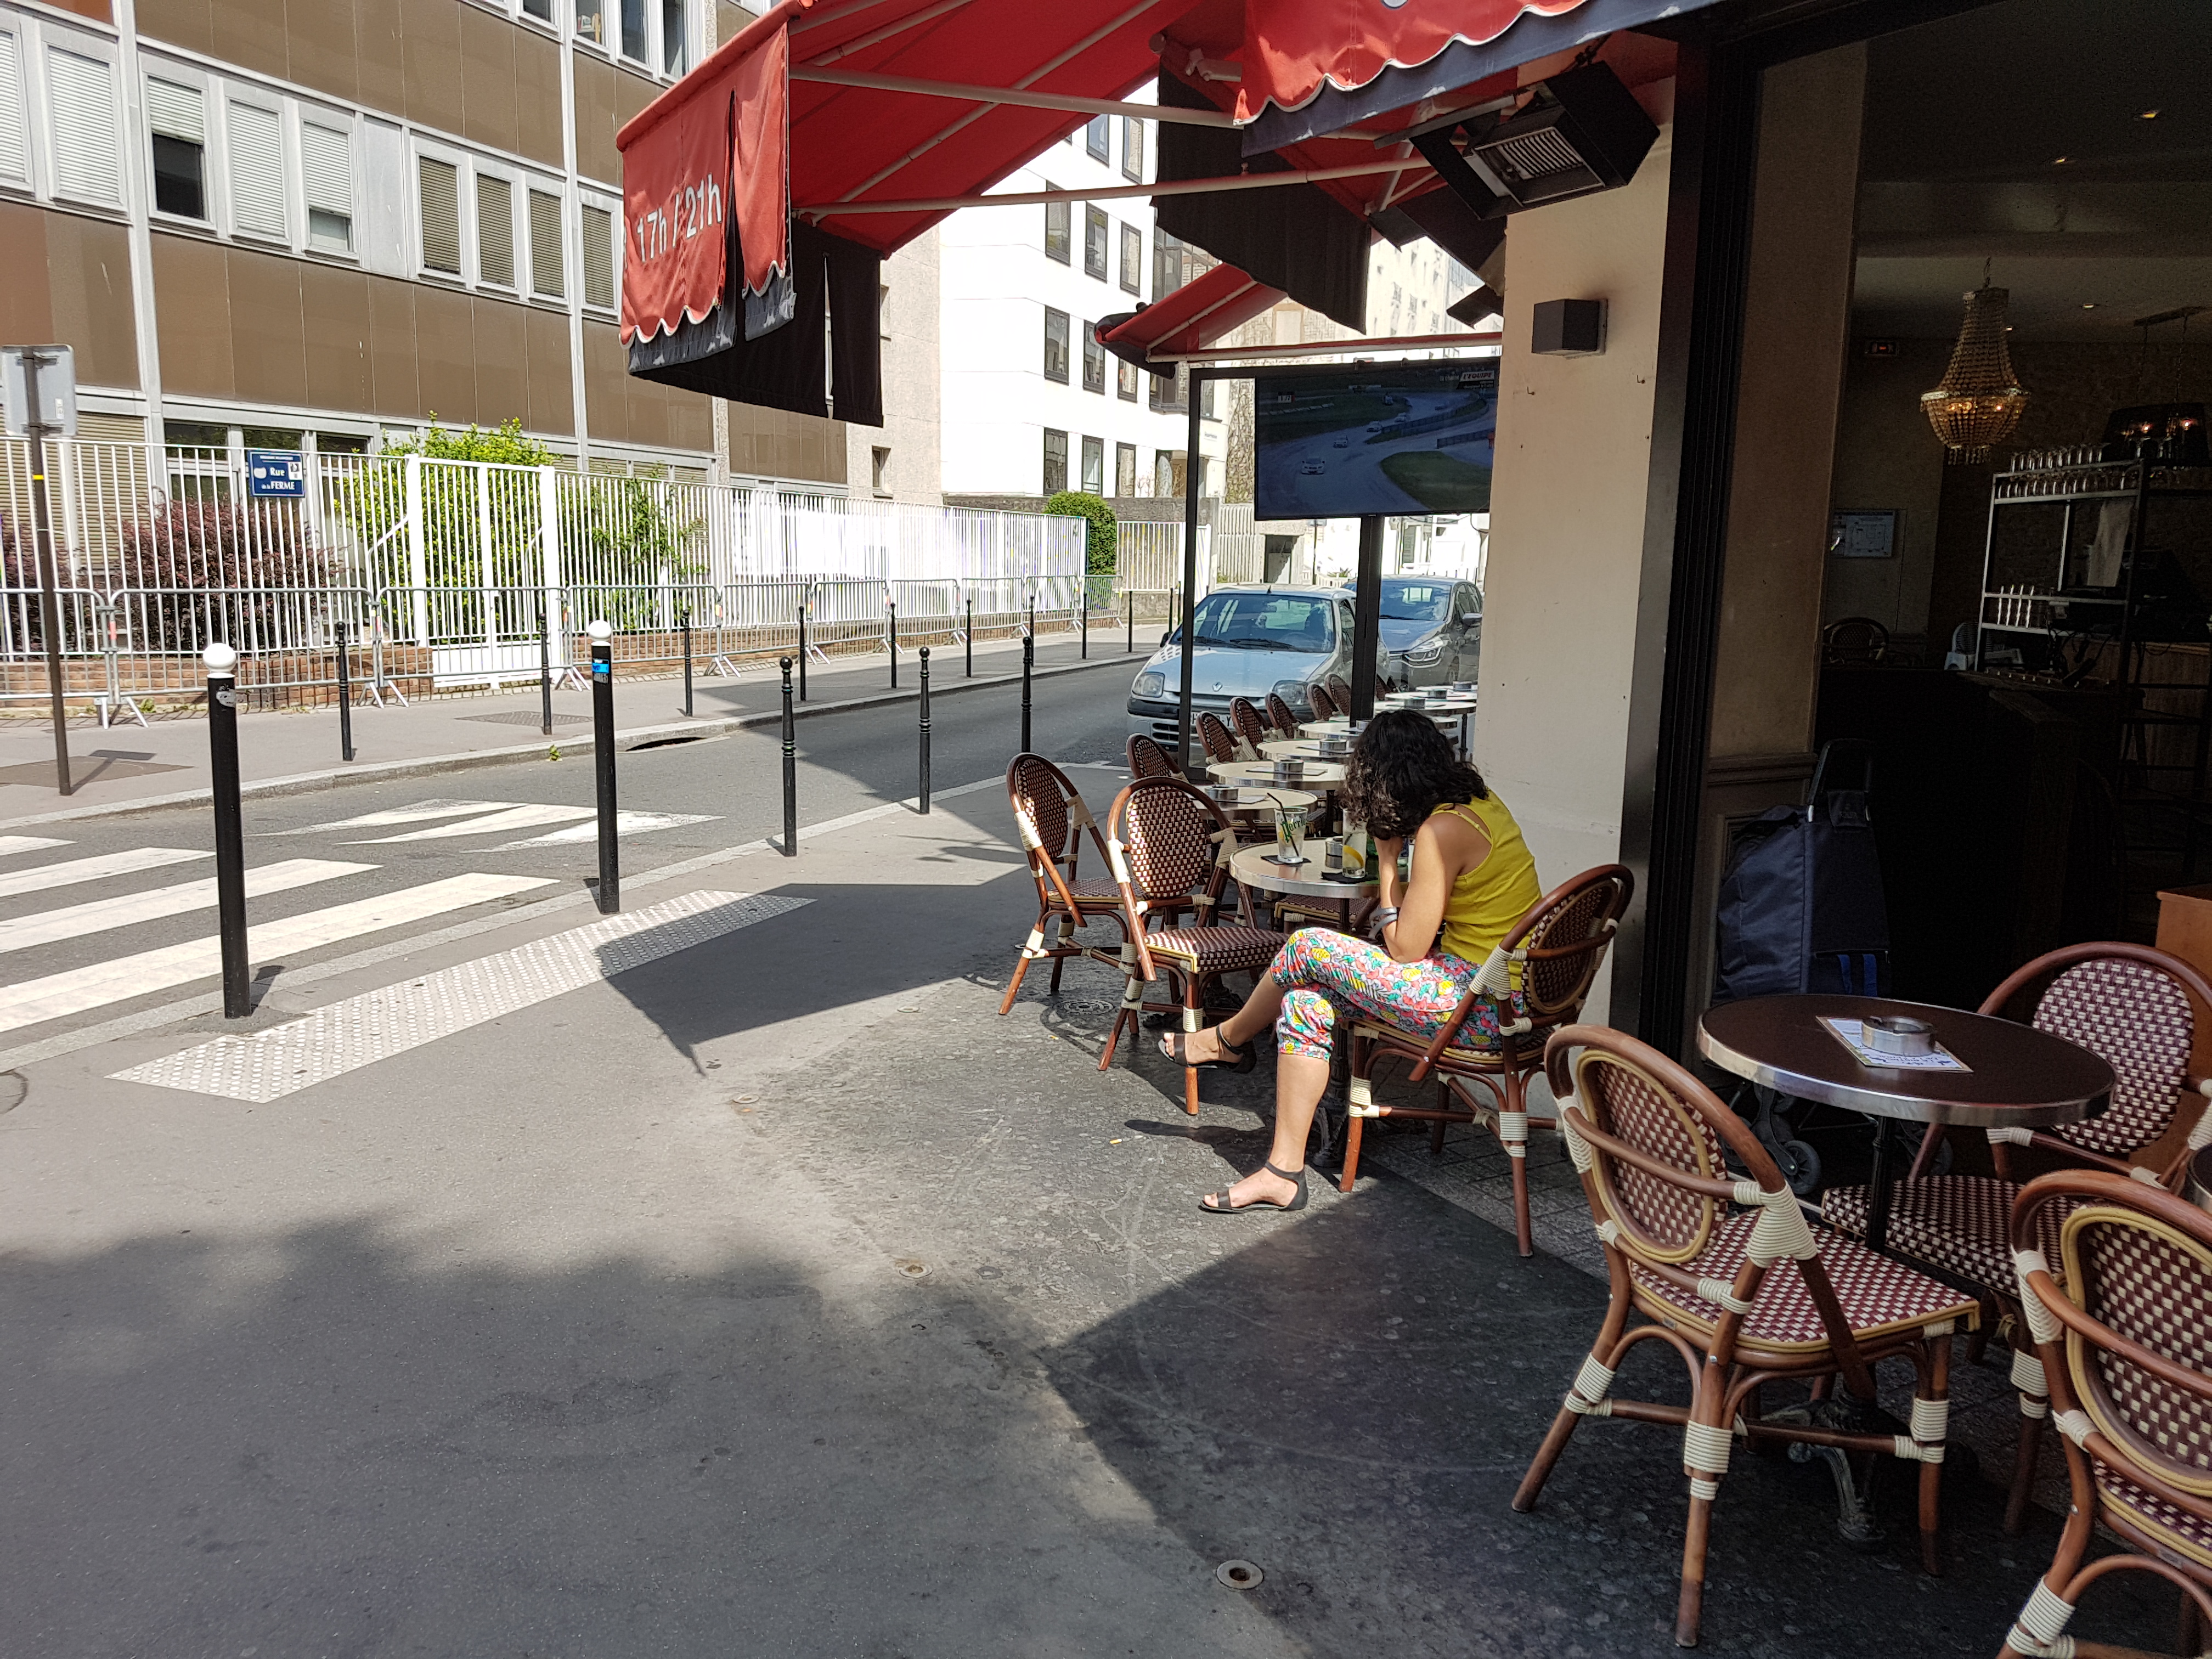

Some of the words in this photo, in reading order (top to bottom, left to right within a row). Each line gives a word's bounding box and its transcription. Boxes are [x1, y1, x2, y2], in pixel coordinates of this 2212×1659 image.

[637, 207, 667, 262] 17h
[685, 173, 722, 239] 21h
[269, 467, 285, 476] Rue
[270, 481, 295, 490] FERME
